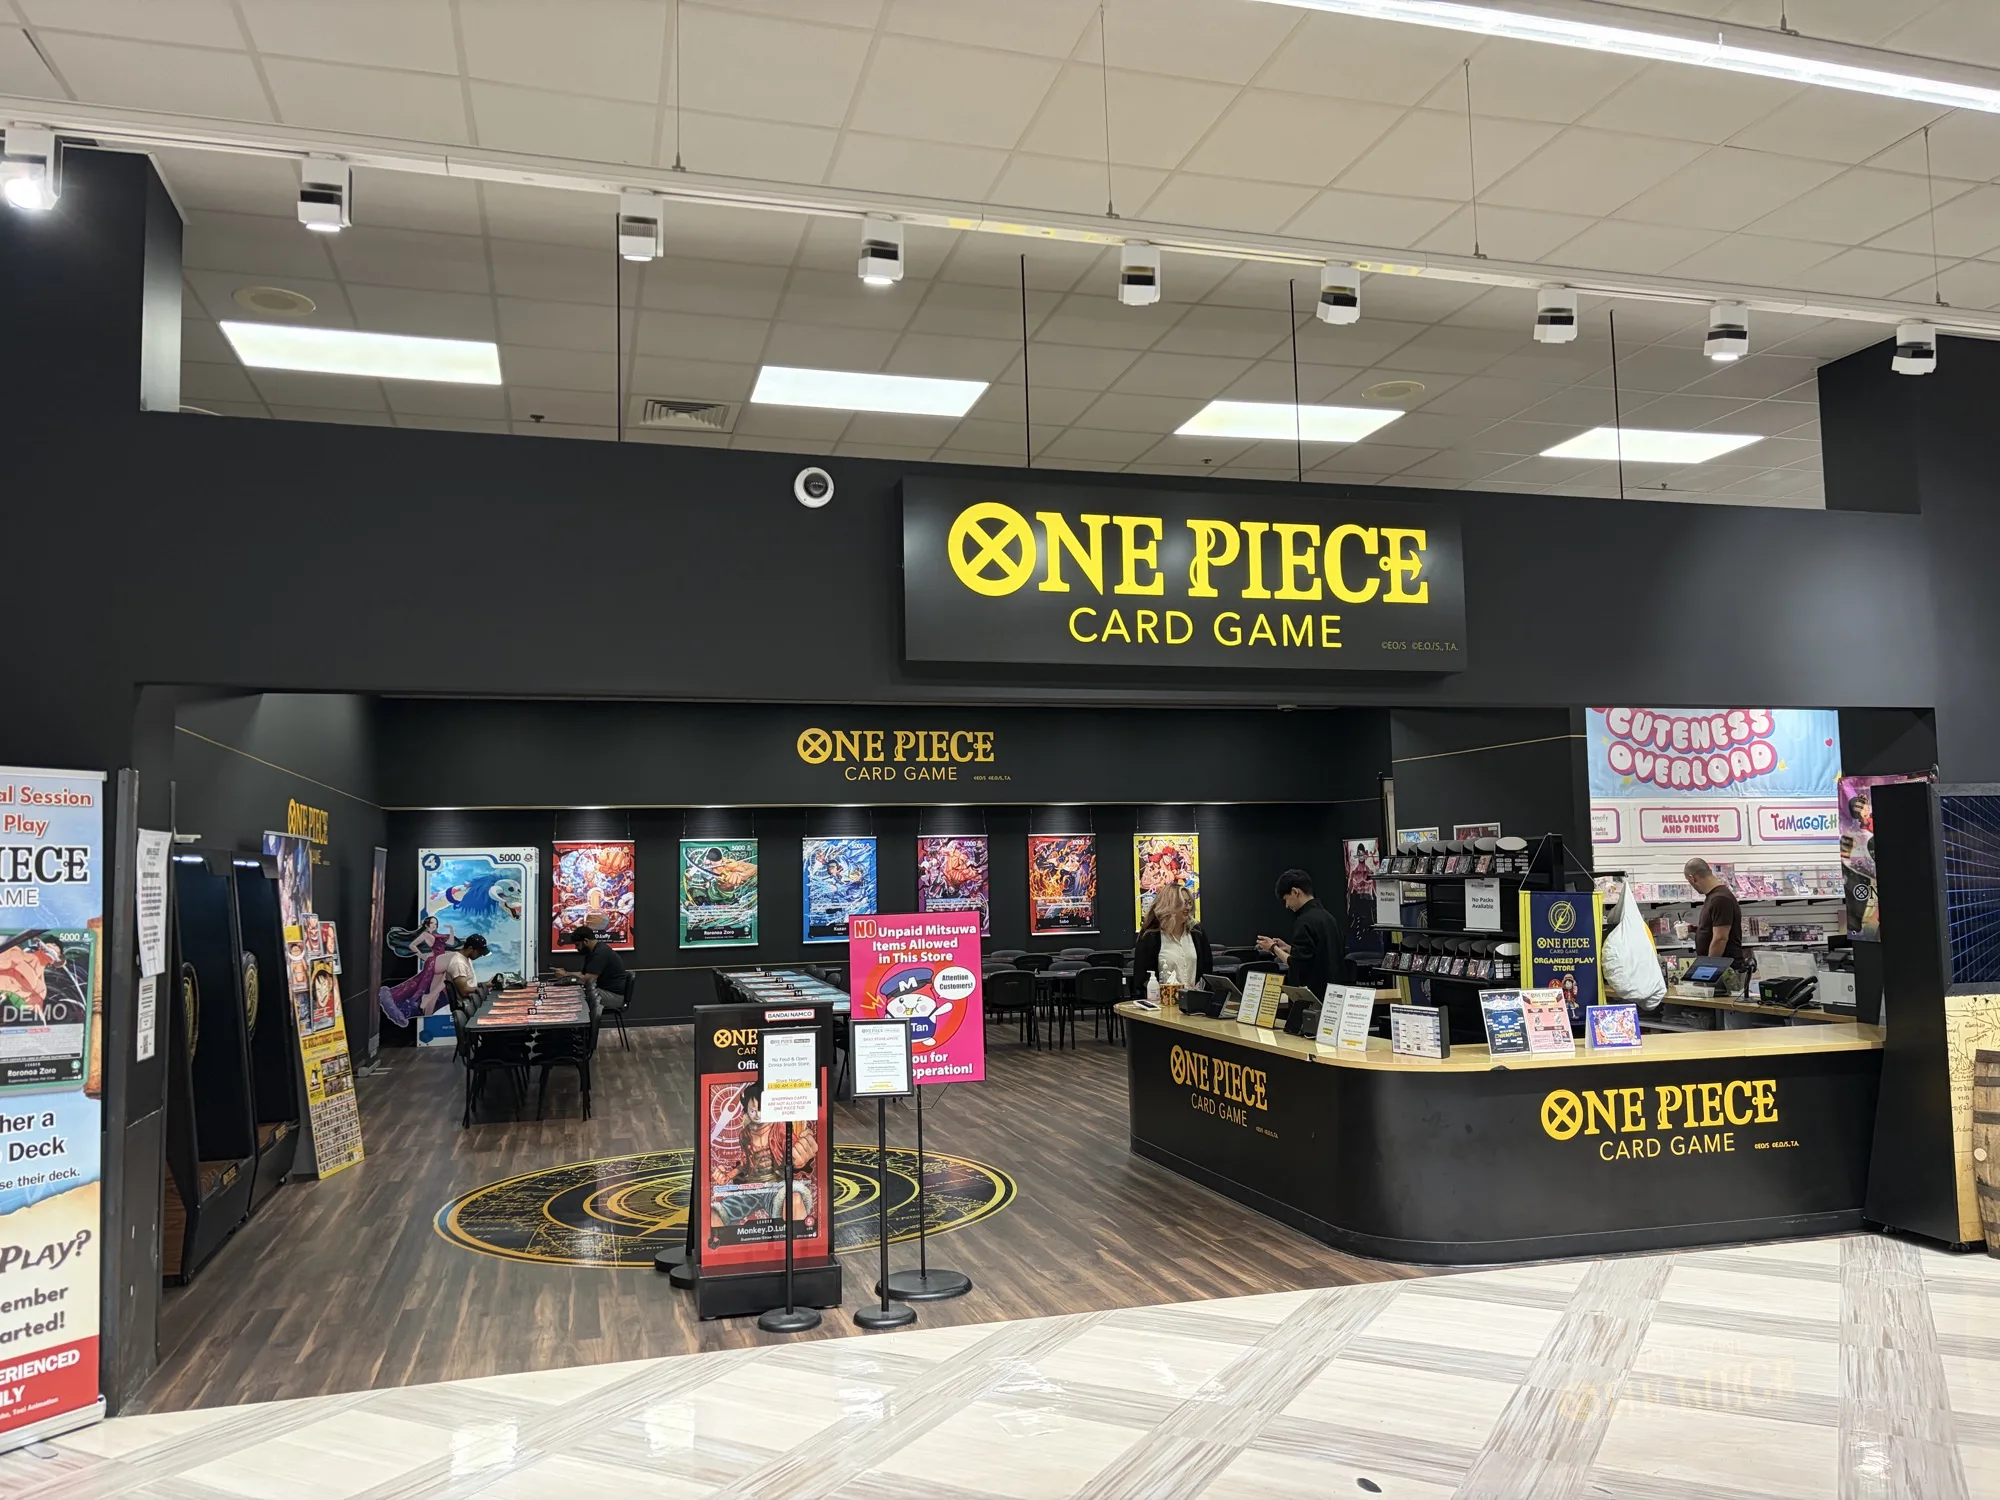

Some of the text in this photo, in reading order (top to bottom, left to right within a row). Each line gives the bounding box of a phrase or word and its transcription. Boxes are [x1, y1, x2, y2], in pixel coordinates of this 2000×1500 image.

[948, 502, 1428, 603] ONE PIECE
[1069, 607, 1342, 648] CARD GAME
[1607, 708, 1775, 751] CUTENESS
[797, 728, 994, 764] ONE PIECE
[845, 766, 957, 781] CARD GAME
[1609, 742, 1776, 788] OVERLOAD
[20, 786, 92, 806] Session
[4, 814, 46, 837] Play
[1662, 814, 1719, 823] HELLO KITTY
[1663, 824, 1719, 834] AND FRIENDS
[423, 855, 438, 868] 4
[499, 853, 521, 862] 5000
[0, 889, 38, 905] ME
[59, 933, 80, 942] 5000
[854, 920, 976, 939] NO Unpaid Mitsuwa
[872, 938, 958, 951] Items Allowed
[1537, 937, 1590, 949] ONE PIECE
[879, 952, 953, 964] in This Store
[898, 977, 918, 992] M
[3, 1003, 67, 1023] DEMO
[911, 1023, 929, 1032] Tan
[714, 1029, 758, 1048] ONE
[737, 1047, 756, 1055] CAR
[930, 1051, 948, 1062] for
[39, 1067, 56, 1075] Zoro
[1171, 1045, 1267, 1111] ONE PIECE
[1192, 1093, 1247, 1127] CARD GAME
[1541, 1080, 1778, 1140] ONE PIECE
[0, 1112, 54, 1133] her a
[9, 1136, 65, 1161] Deck
[1600, 1132, 1735, 1160] CARD GAME
[18, 1173, 45, 1187] their
[49, 1166, 80, 1181] deck.
[0, 1287, 68, 1313] ember
[0, 1311, 65, 1344] arted!
